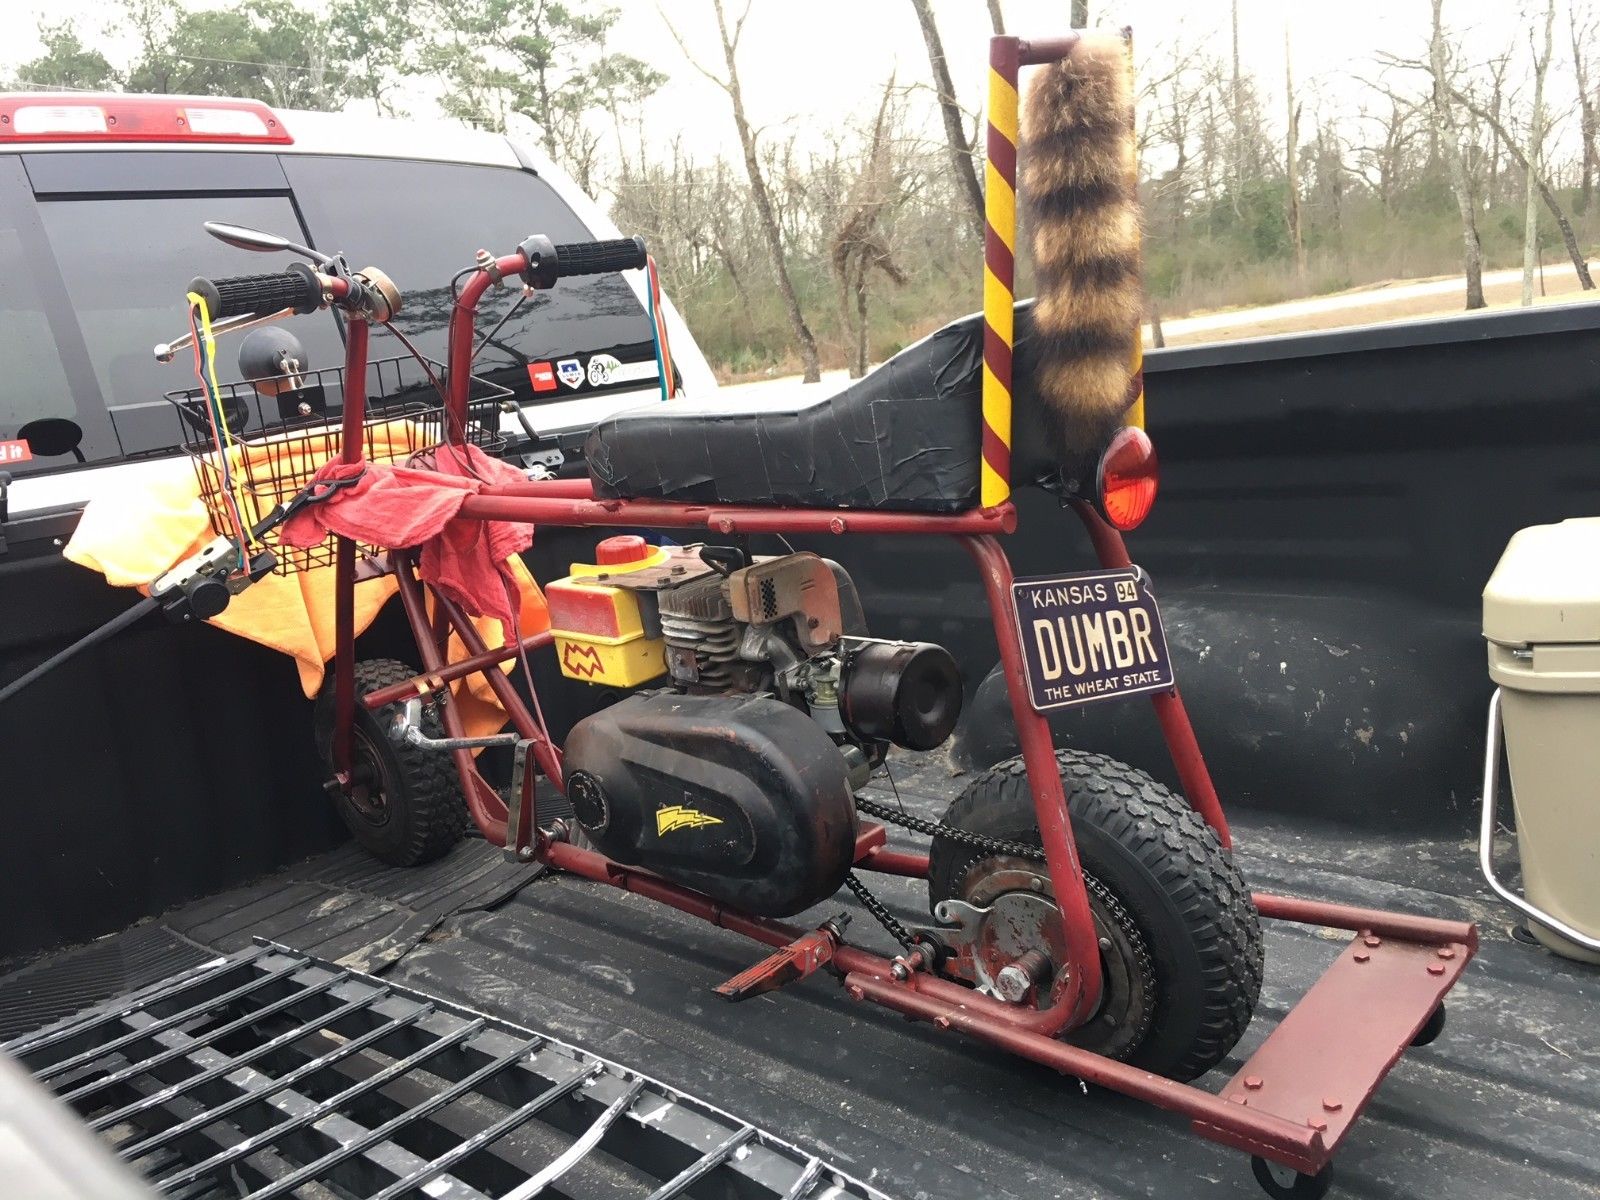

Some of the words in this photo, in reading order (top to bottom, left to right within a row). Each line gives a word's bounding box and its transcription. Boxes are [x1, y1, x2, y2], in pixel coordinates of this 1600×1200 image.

[1031, 584, 1107, 608] KANSAS
[1117, 582, 1136, 601] 94
[1033, 607, 1158, 680] DUMBR
[1045, 688, 1072, 701] THE
[1075, 677, 1119, 694] WHEAT
[1123, 670, 1161, 686] STATE
